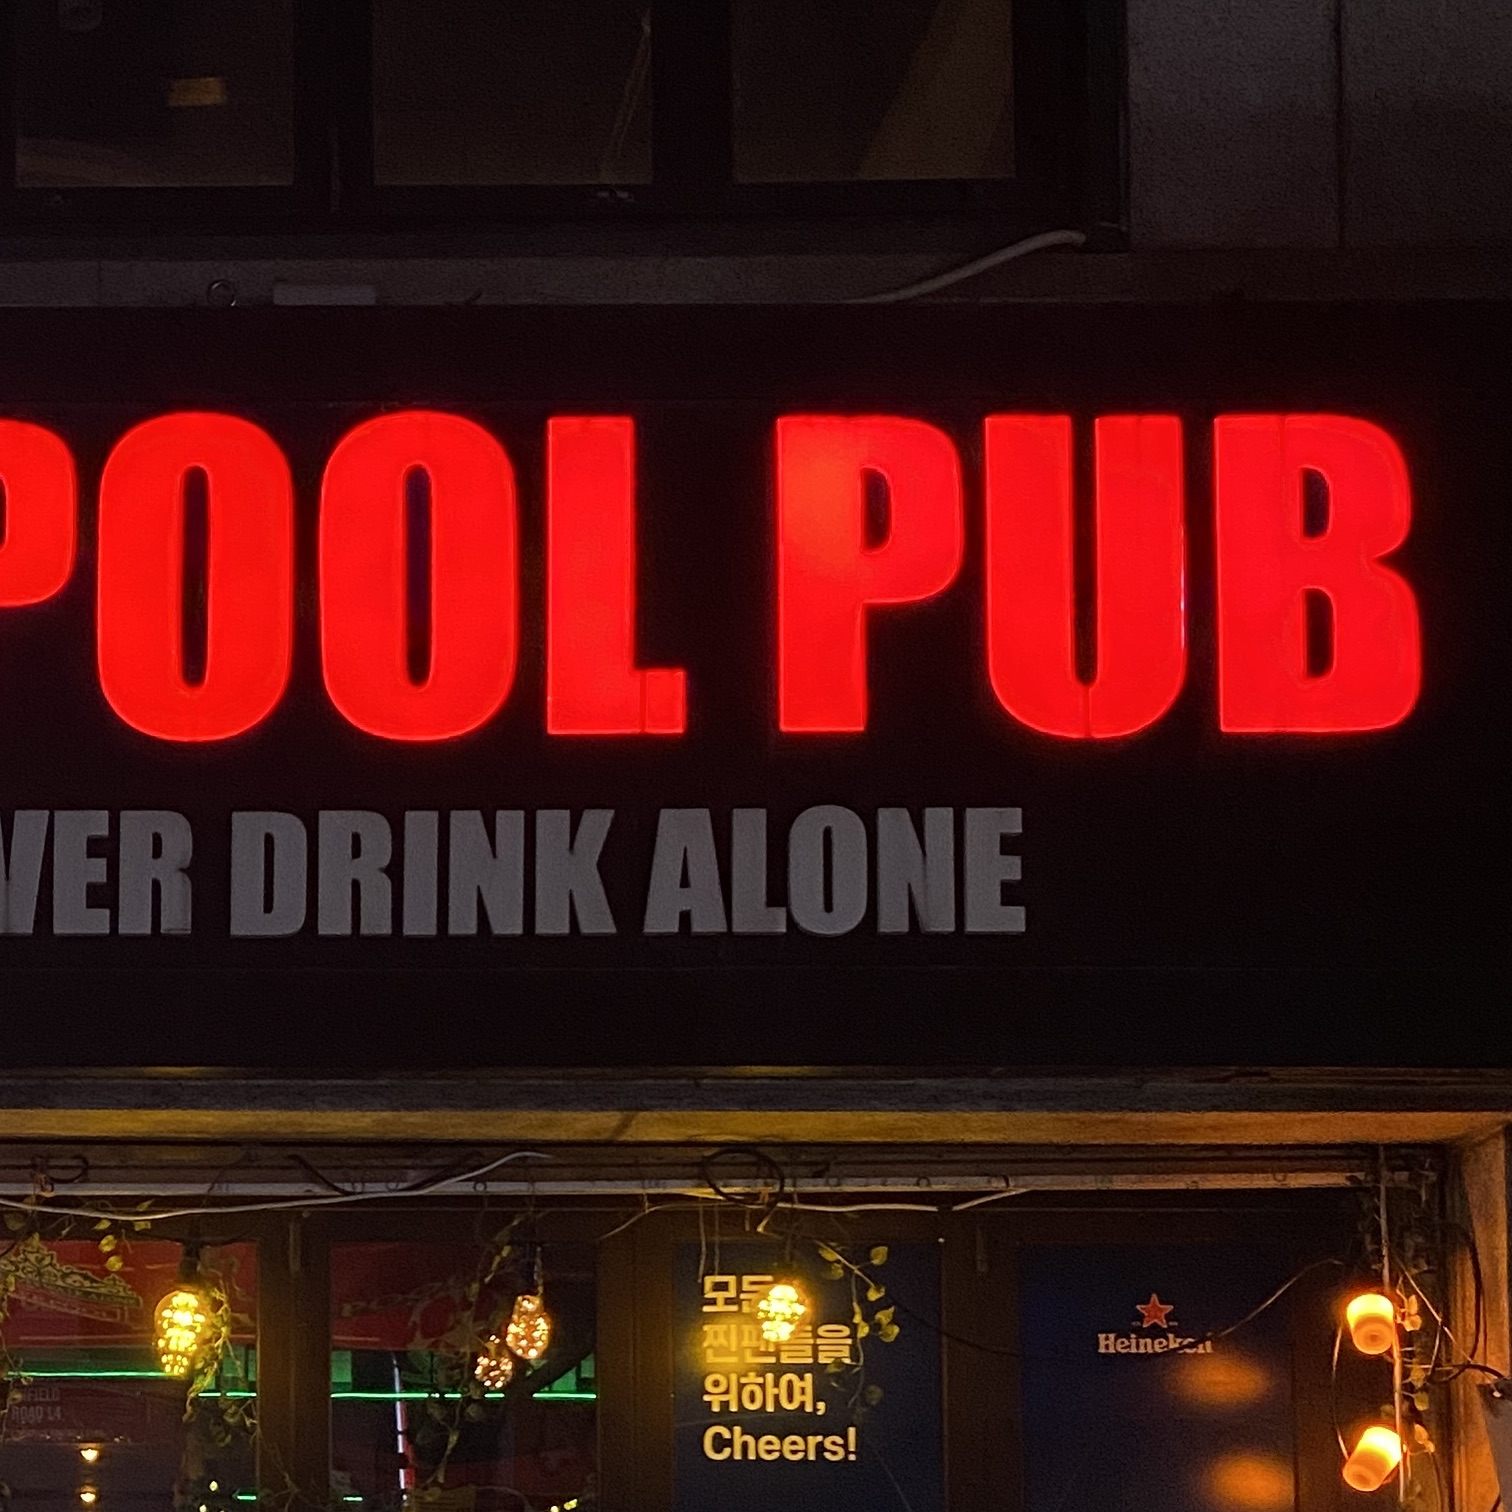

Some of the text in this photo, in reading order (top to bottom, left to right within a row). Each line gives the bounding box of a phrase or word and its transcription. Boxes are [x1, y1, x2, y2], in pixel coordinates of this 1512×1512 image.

[775, 412, 1423, 740] PUB
[229, 808, 615, 938] DRINK
[643, 804, 1028, 938] ALONE
[702, 1372, 827, 1416] 위하여,
[702, 1425, 857, 1461] Cheers!
